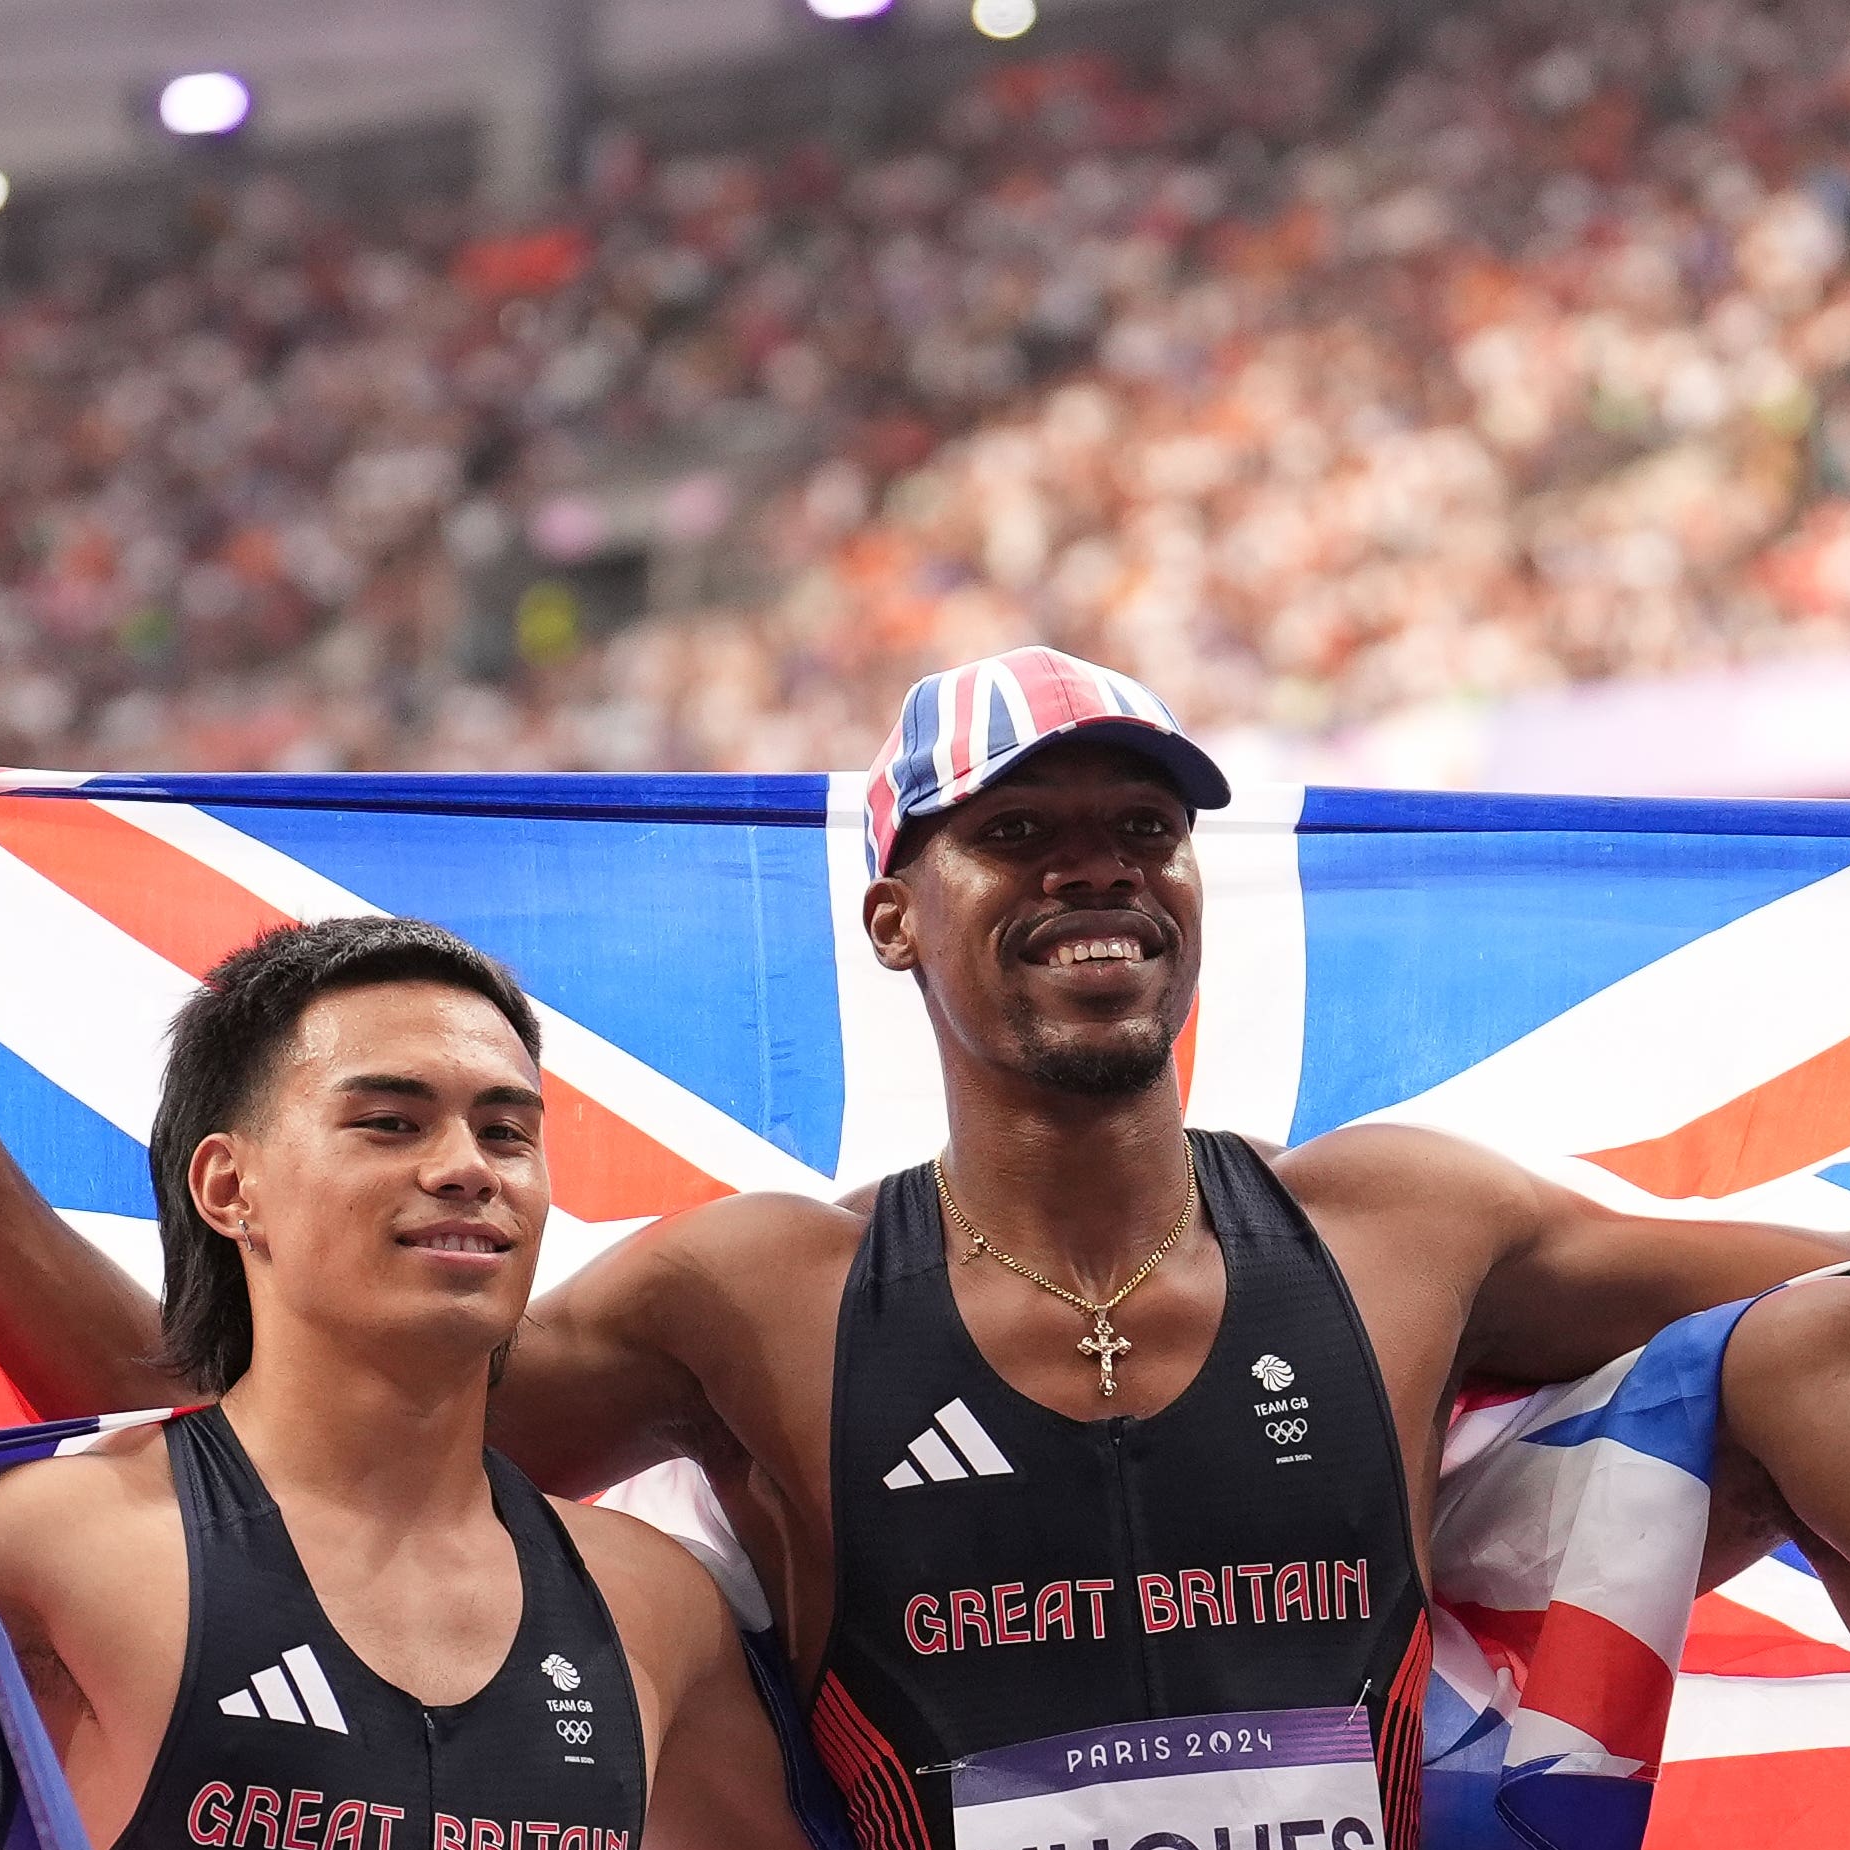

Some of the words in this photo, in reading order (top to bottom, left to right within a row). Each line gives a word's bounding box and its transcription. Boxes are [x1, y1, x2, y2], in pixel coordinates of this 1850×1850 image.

[1253, 1399, 1289, 1417] TEAM
[1290, 1396, 1309, 1410] GB
[904, 1579, 1114, 1656] GREAT
[1137, 1558, 1370, 1634] BRITAIN
[546, 1699, 577, 1713] TEAM
[577, 1699, 594, 1713] GB
[1066, 1735, 1172, 1773] PARIS
[1185, 1727, 1274, 1759] 2024
